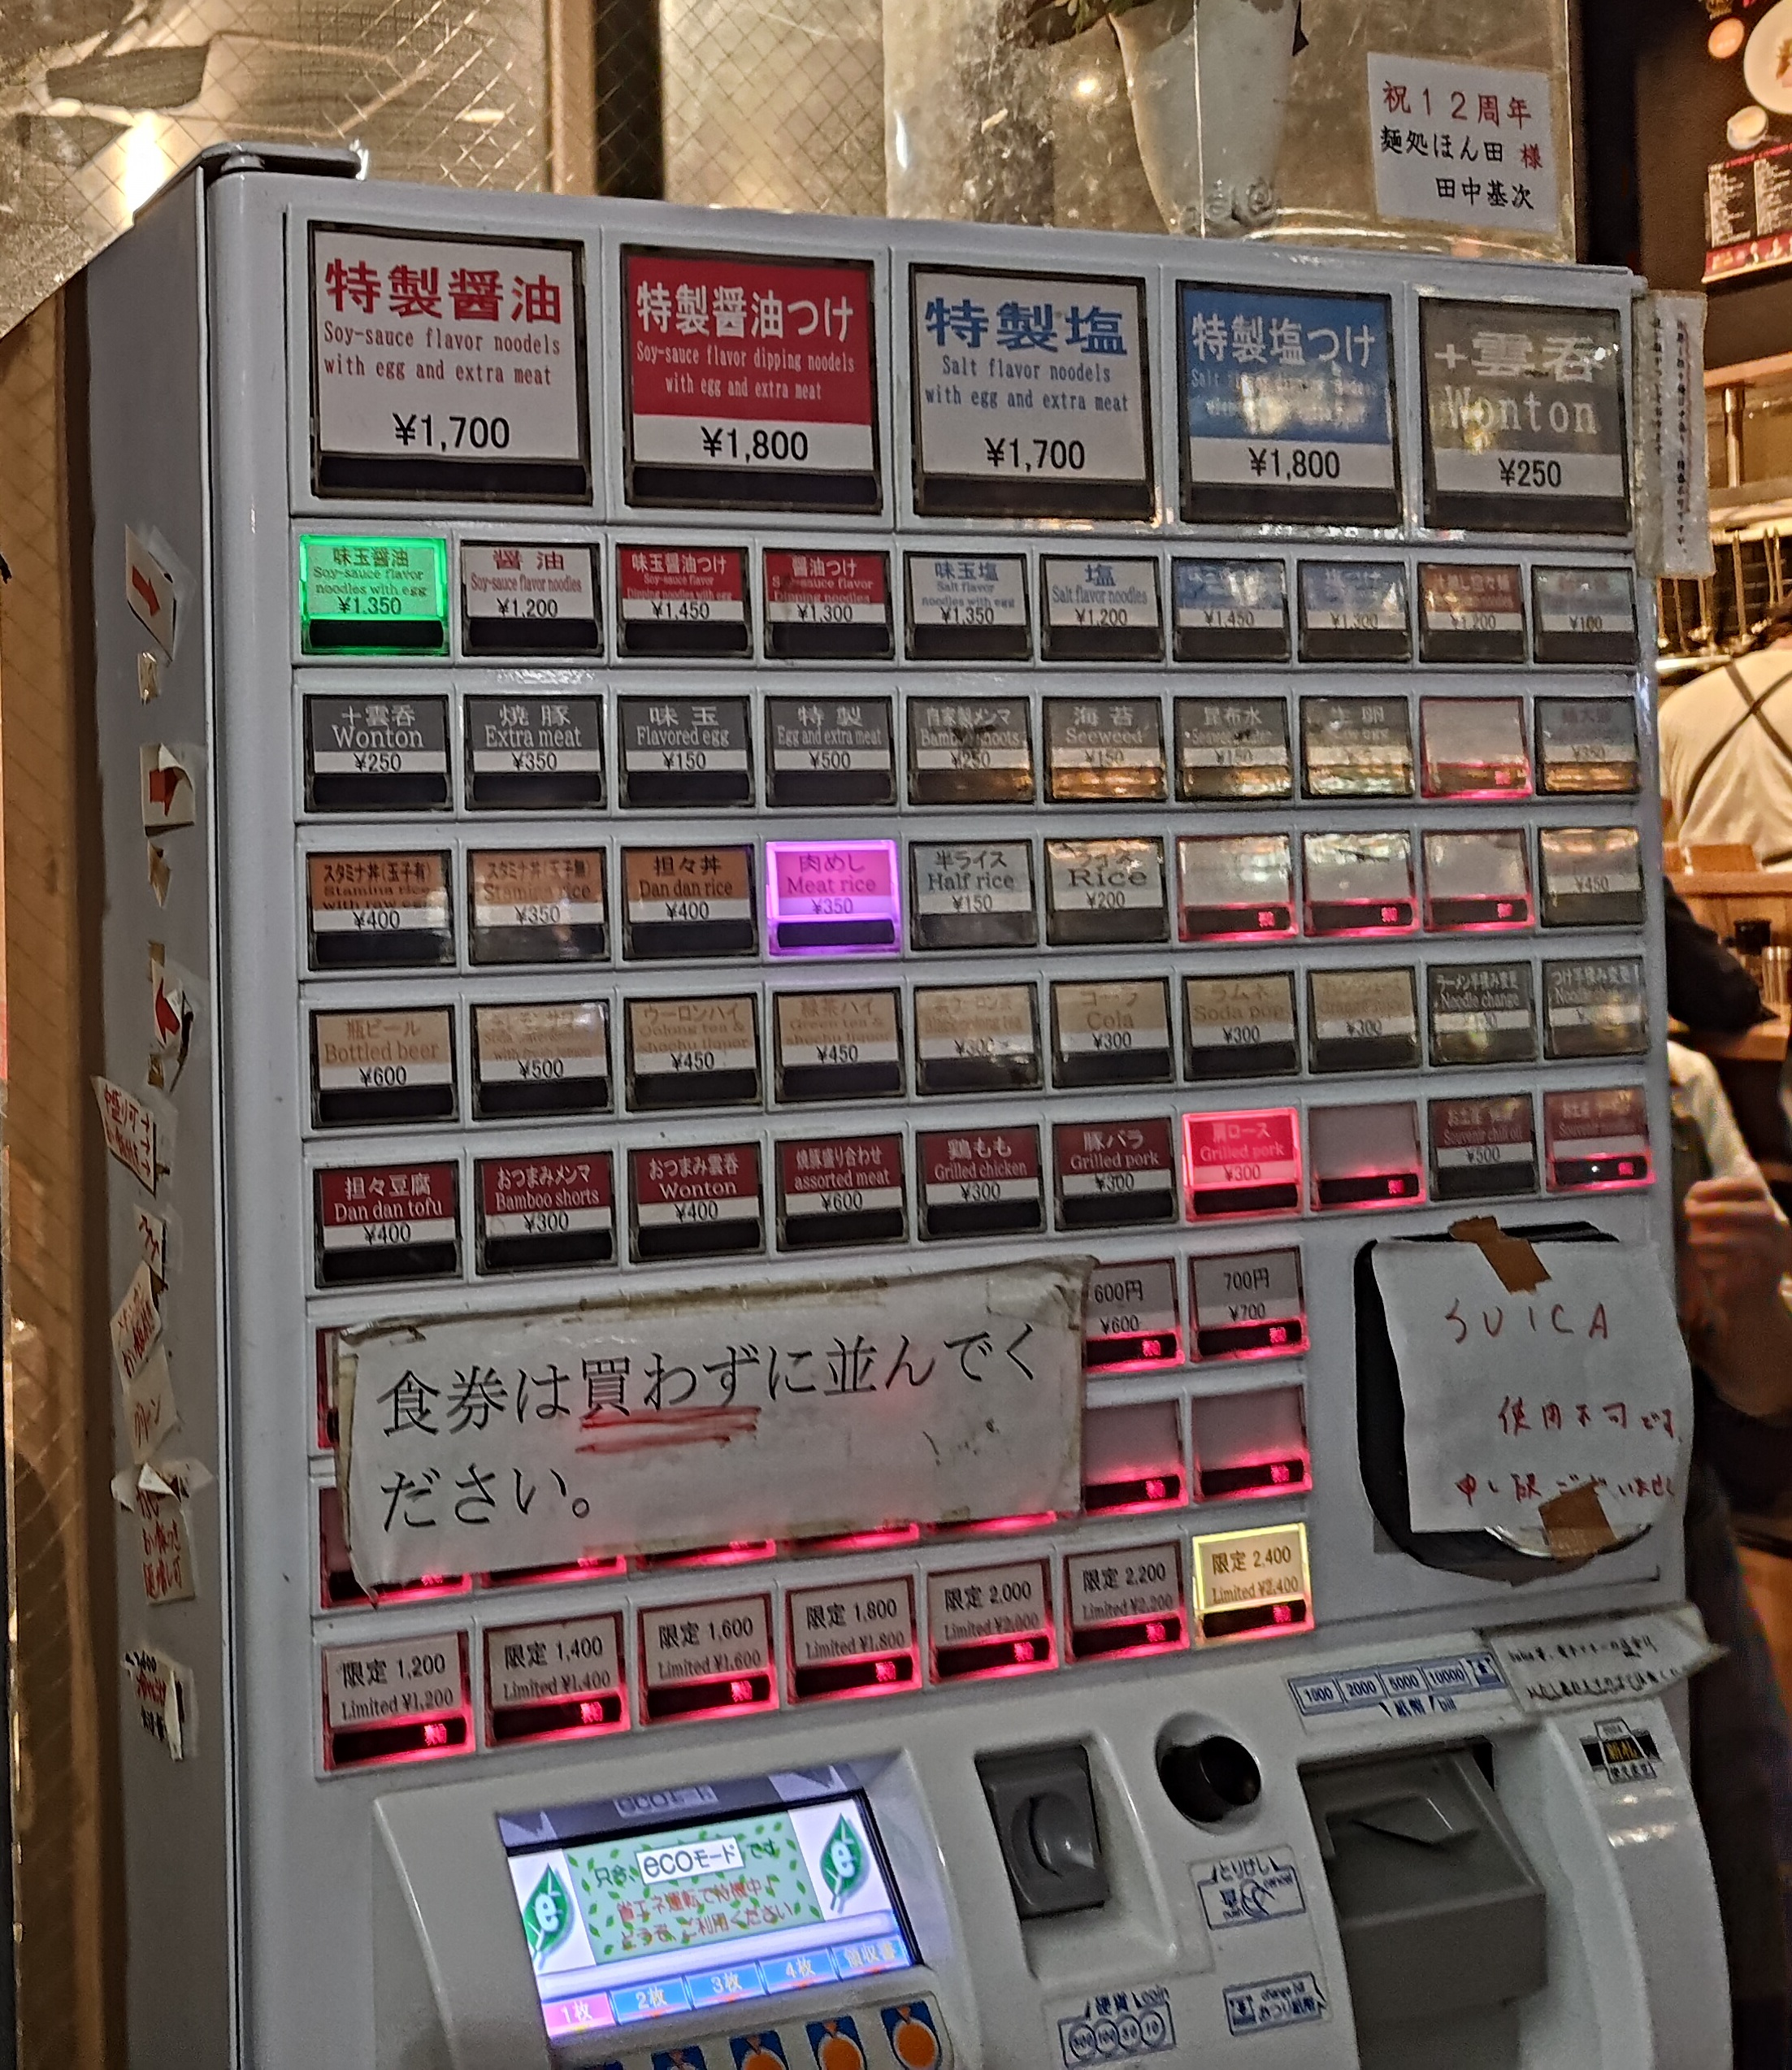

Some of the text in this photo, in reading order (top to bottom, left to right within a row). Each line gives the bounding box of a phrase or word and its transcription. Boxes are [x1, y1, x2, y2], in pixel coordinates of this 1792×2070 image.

[1436, 176, 1534, 210] 田中基次
[325, 258, 561, 324] 特製醤油
[637, 281, 853, 342] 特製醤油つけ
[325, 321, 560, 355] Soy-sauce flavor noodels
[925, 297, 1127, 355] 特製塩
[1192, 312, 1375, 367] 特製塩つけ
[637, 341, 855, 372] Soy-sauce flavor dipping noodels
[943, 355, 1110, 383] Salt flavor noodels
[325, 354, 551, 385] with egg and extra meat
[666, 373, 822, 400] with egg and extra meat
[925, 385, 1128, 411] with egg and extra meat
[393, 413, 510, 452] ¥1,700
[701, 426, 808, 463] ¥1,800
[985, 437, 1085, 473] ¥1,700
[1249, 447, 1340, 481] ¥1,800
[1498, 458, 1561, 488] ¥250
[332, 724, 424, 749] Wonton
[484, 724, 582, 749] Extra meat
[636, 726, 729, 747] Flavored egg
[777, 726, 799, 747] Egg
[824, 728, 853, 745] extra
[353, 753, 401, 773] ¥250
[662, 751, 705, 770] ¥150
[639, 879, 732, 897] Dan dan rice
[788, 877, 876, 894] Meat rice
[928, 872, 1013, 891] Half rice
[1068, 868, 1148, 887] Rice
[325, 1041, 440, 1064] Bottled beer
[1070, 1151, 1161, 1170] Grilled pork
[1200, 1141, 1285, 1162] Grilled pork
[794, 1168, 890, 1191] assorted meat
[935, 1161, 1027, 1182] Grilled chicken
[495, 1190, 553, 1212] Bamboo
[659, 1179, 737, 1200] Wonton
[335, 1196, 442, 1222] Dan dan tofu
[1224, 1268, 1269, 1291] 700円
[1445, 1299, 1608, 1343] SUICA
[376, 1322, 1037, 1437] 食券は買わずに並んでく
[381, 1465, 591, 1534] ださい。
[1212, 1551, 1247, 1575] 限定
[1211, 1584, 1256, 1604] Limited
[1305, 1686, 1334, 1703] 1000
[1430, 1669, 1464, 1686] 10000
[644, 1844, 735, 1878] ecoモード
[785, 1958, 816, 1978] 4枚
[710, 1971, 744, 1994] 3枚
[635, 1985, 668, 2010] 2枚
[561, 2001, 594, 2024] 1枚
